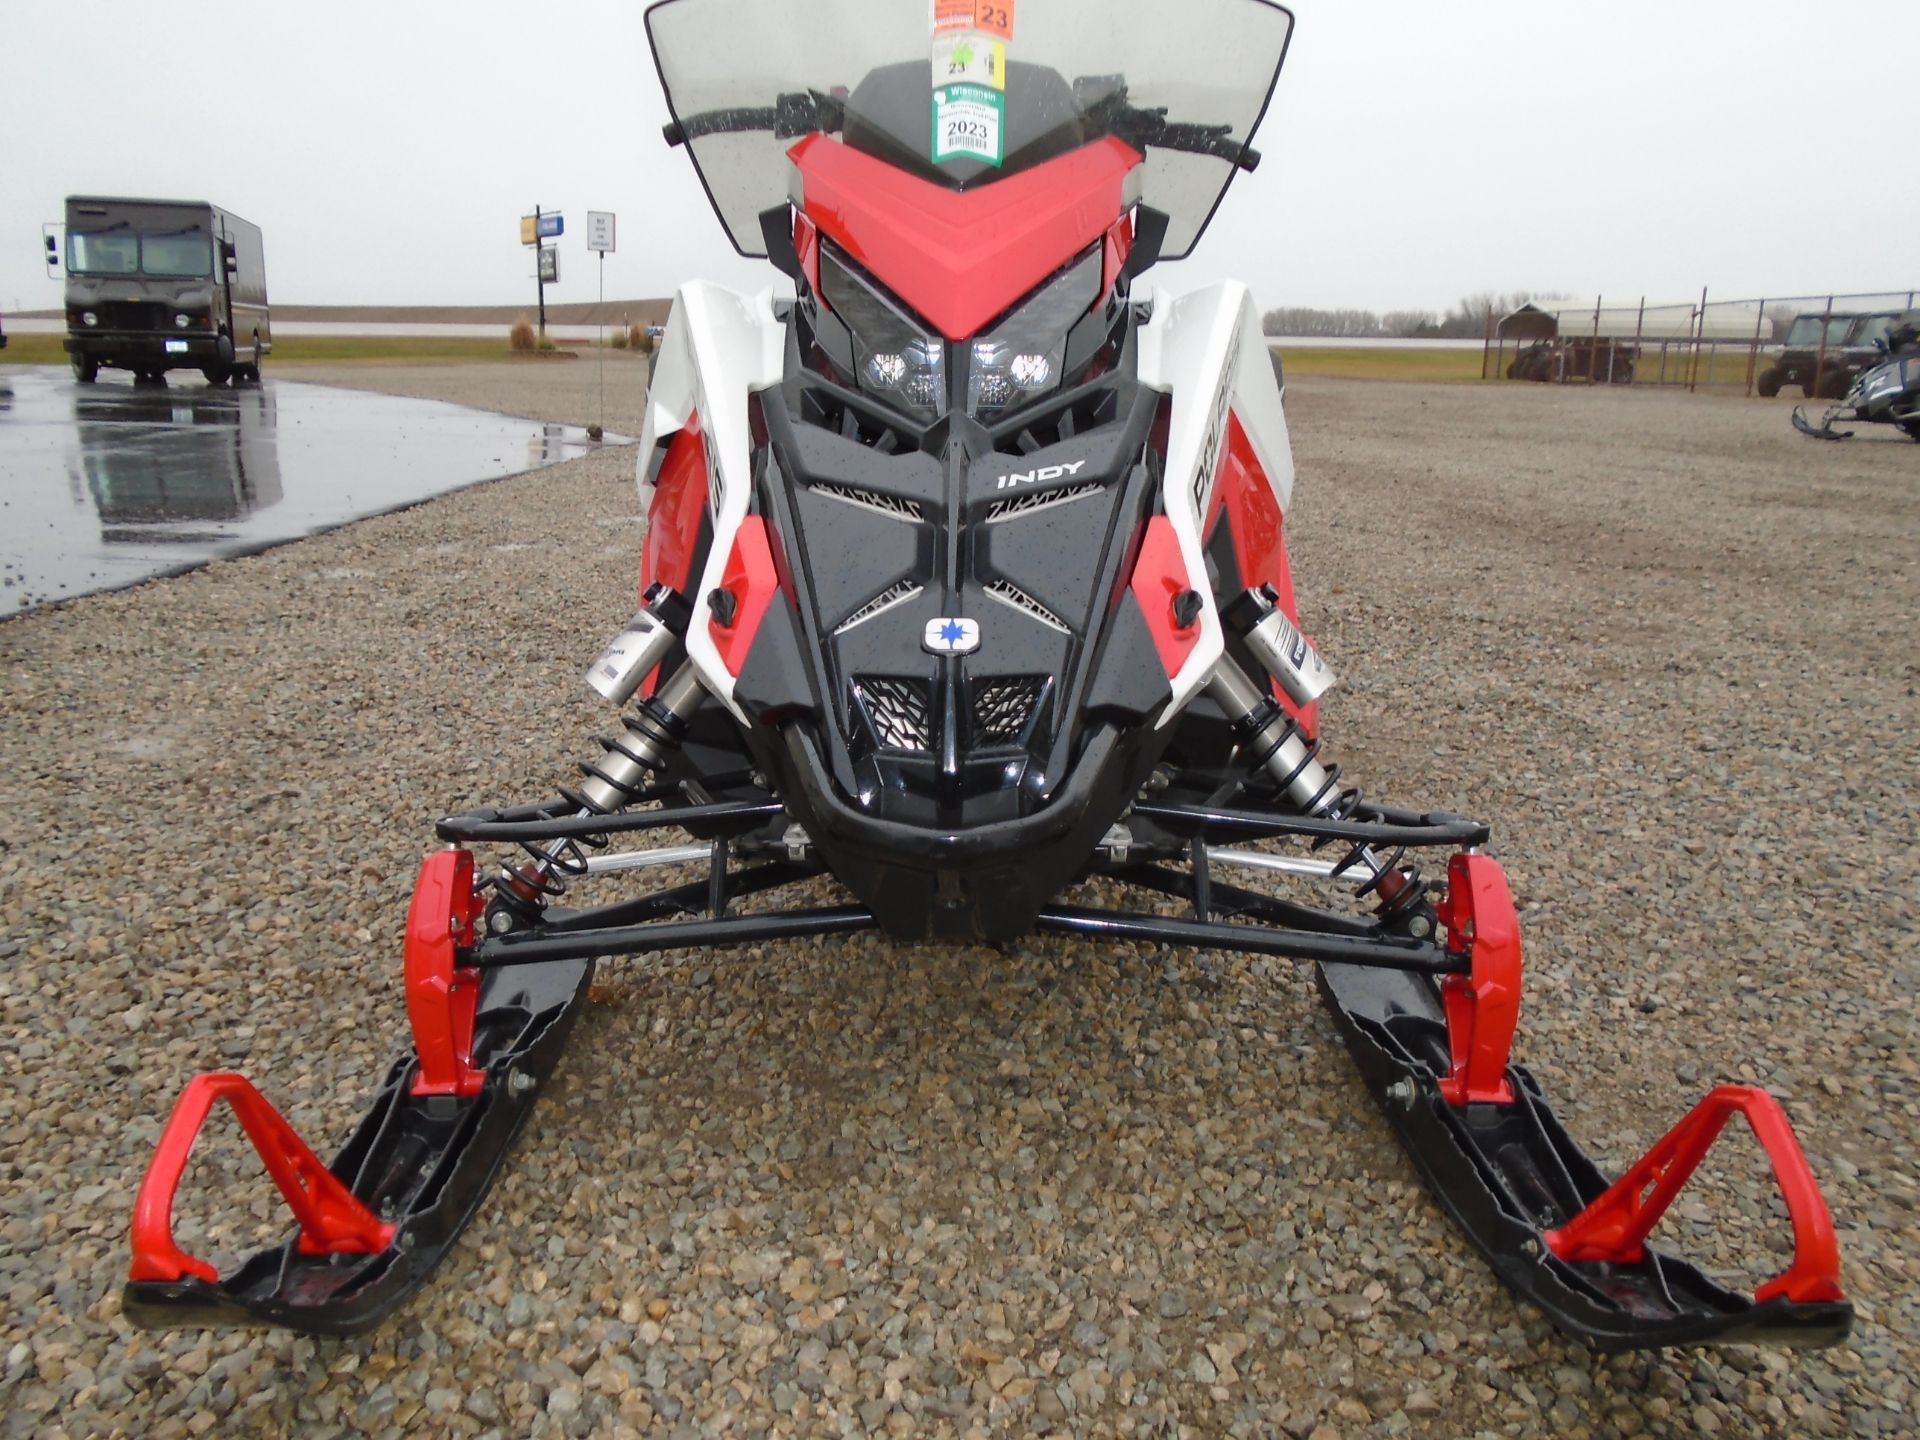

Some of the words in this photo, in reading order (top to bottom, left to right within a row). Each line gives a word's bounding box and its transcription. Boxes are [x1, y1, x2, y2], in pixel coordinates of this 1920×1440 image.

[981, 5, 1008, 28] 23
[951, 86, 996, 102] Wisconsin
[948, 121, 988, 139] 2023
[997, 460, 1086, 489] INDY
